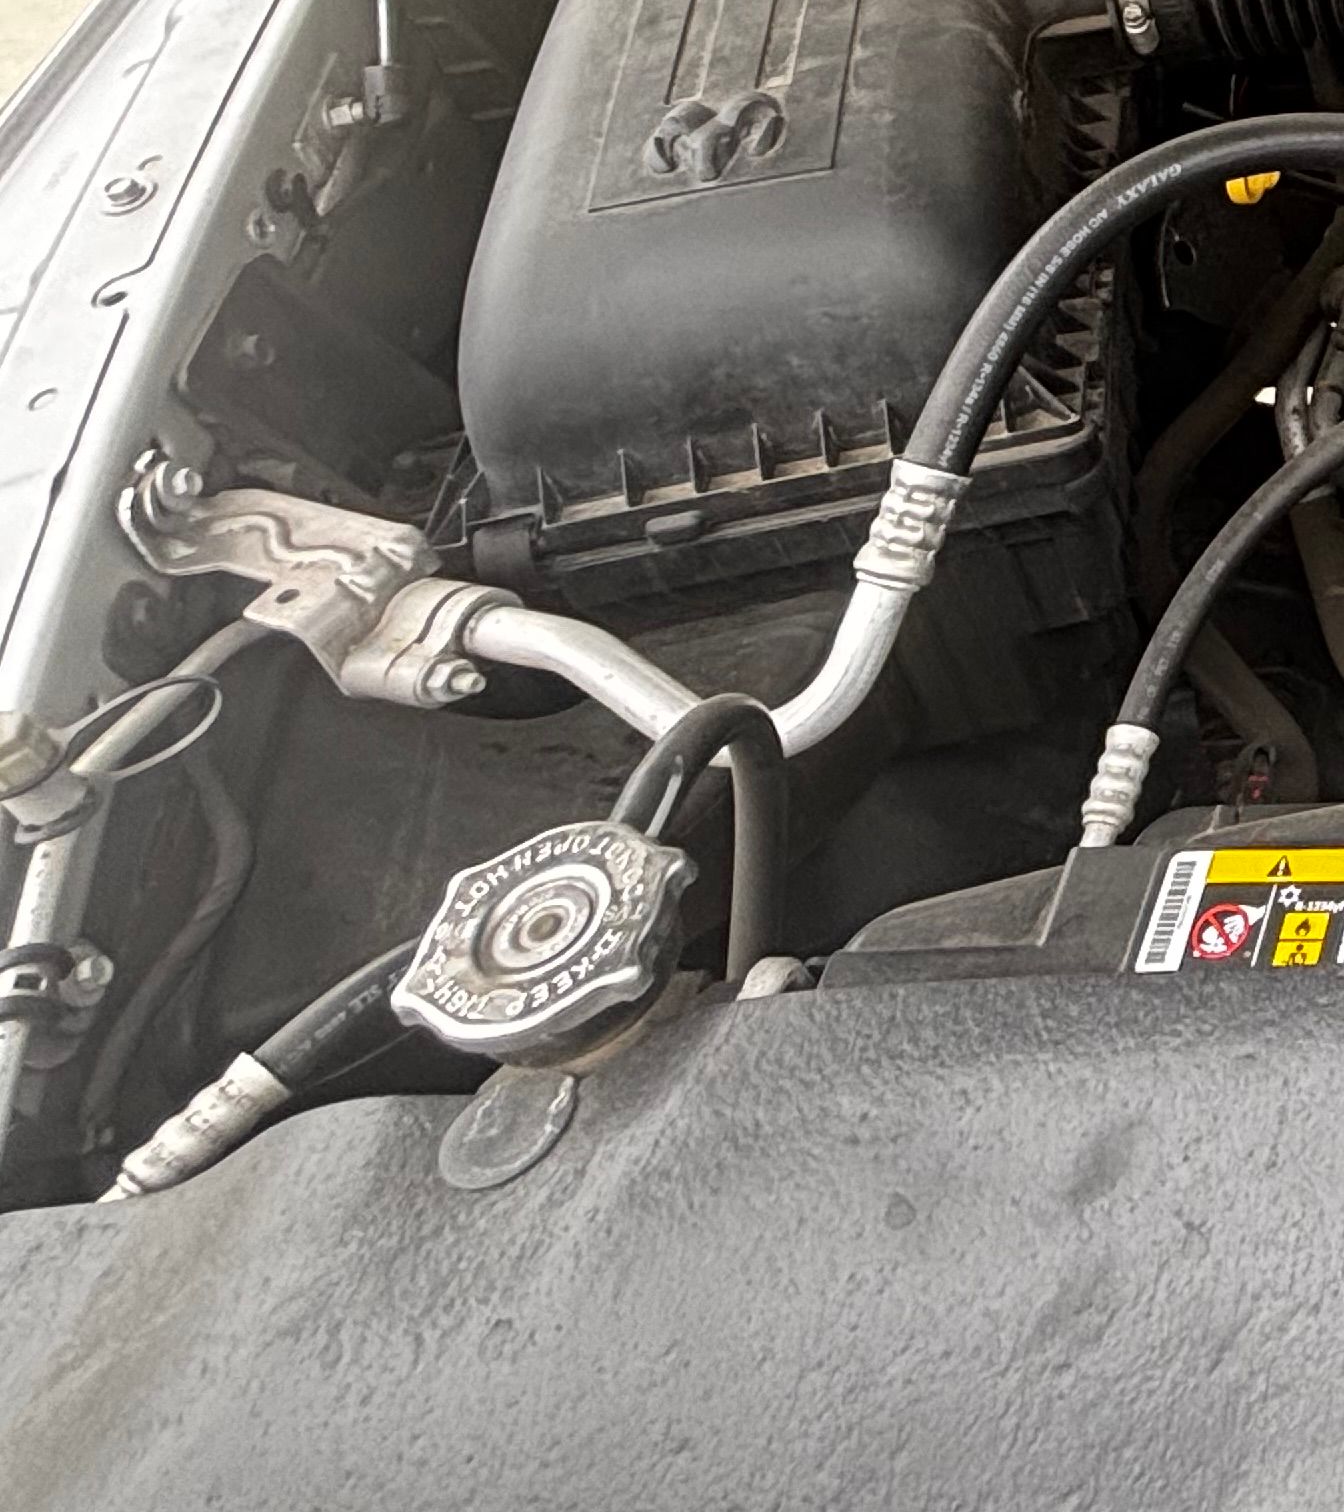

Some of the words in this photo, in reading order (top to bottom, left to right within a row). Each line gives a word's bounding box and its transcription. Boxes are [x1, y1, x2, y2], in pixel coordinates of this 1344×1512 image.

[1115, 163, 1183, 210] GALAXY
[1087, 208, 1109, 230] A/C
[1059, 225, 1092, 258] HOSE
[511, 834, 590, 873] OPEN
[452, 866, 507, 918] HOT
[504, 955, 594, 1016] KEEP
